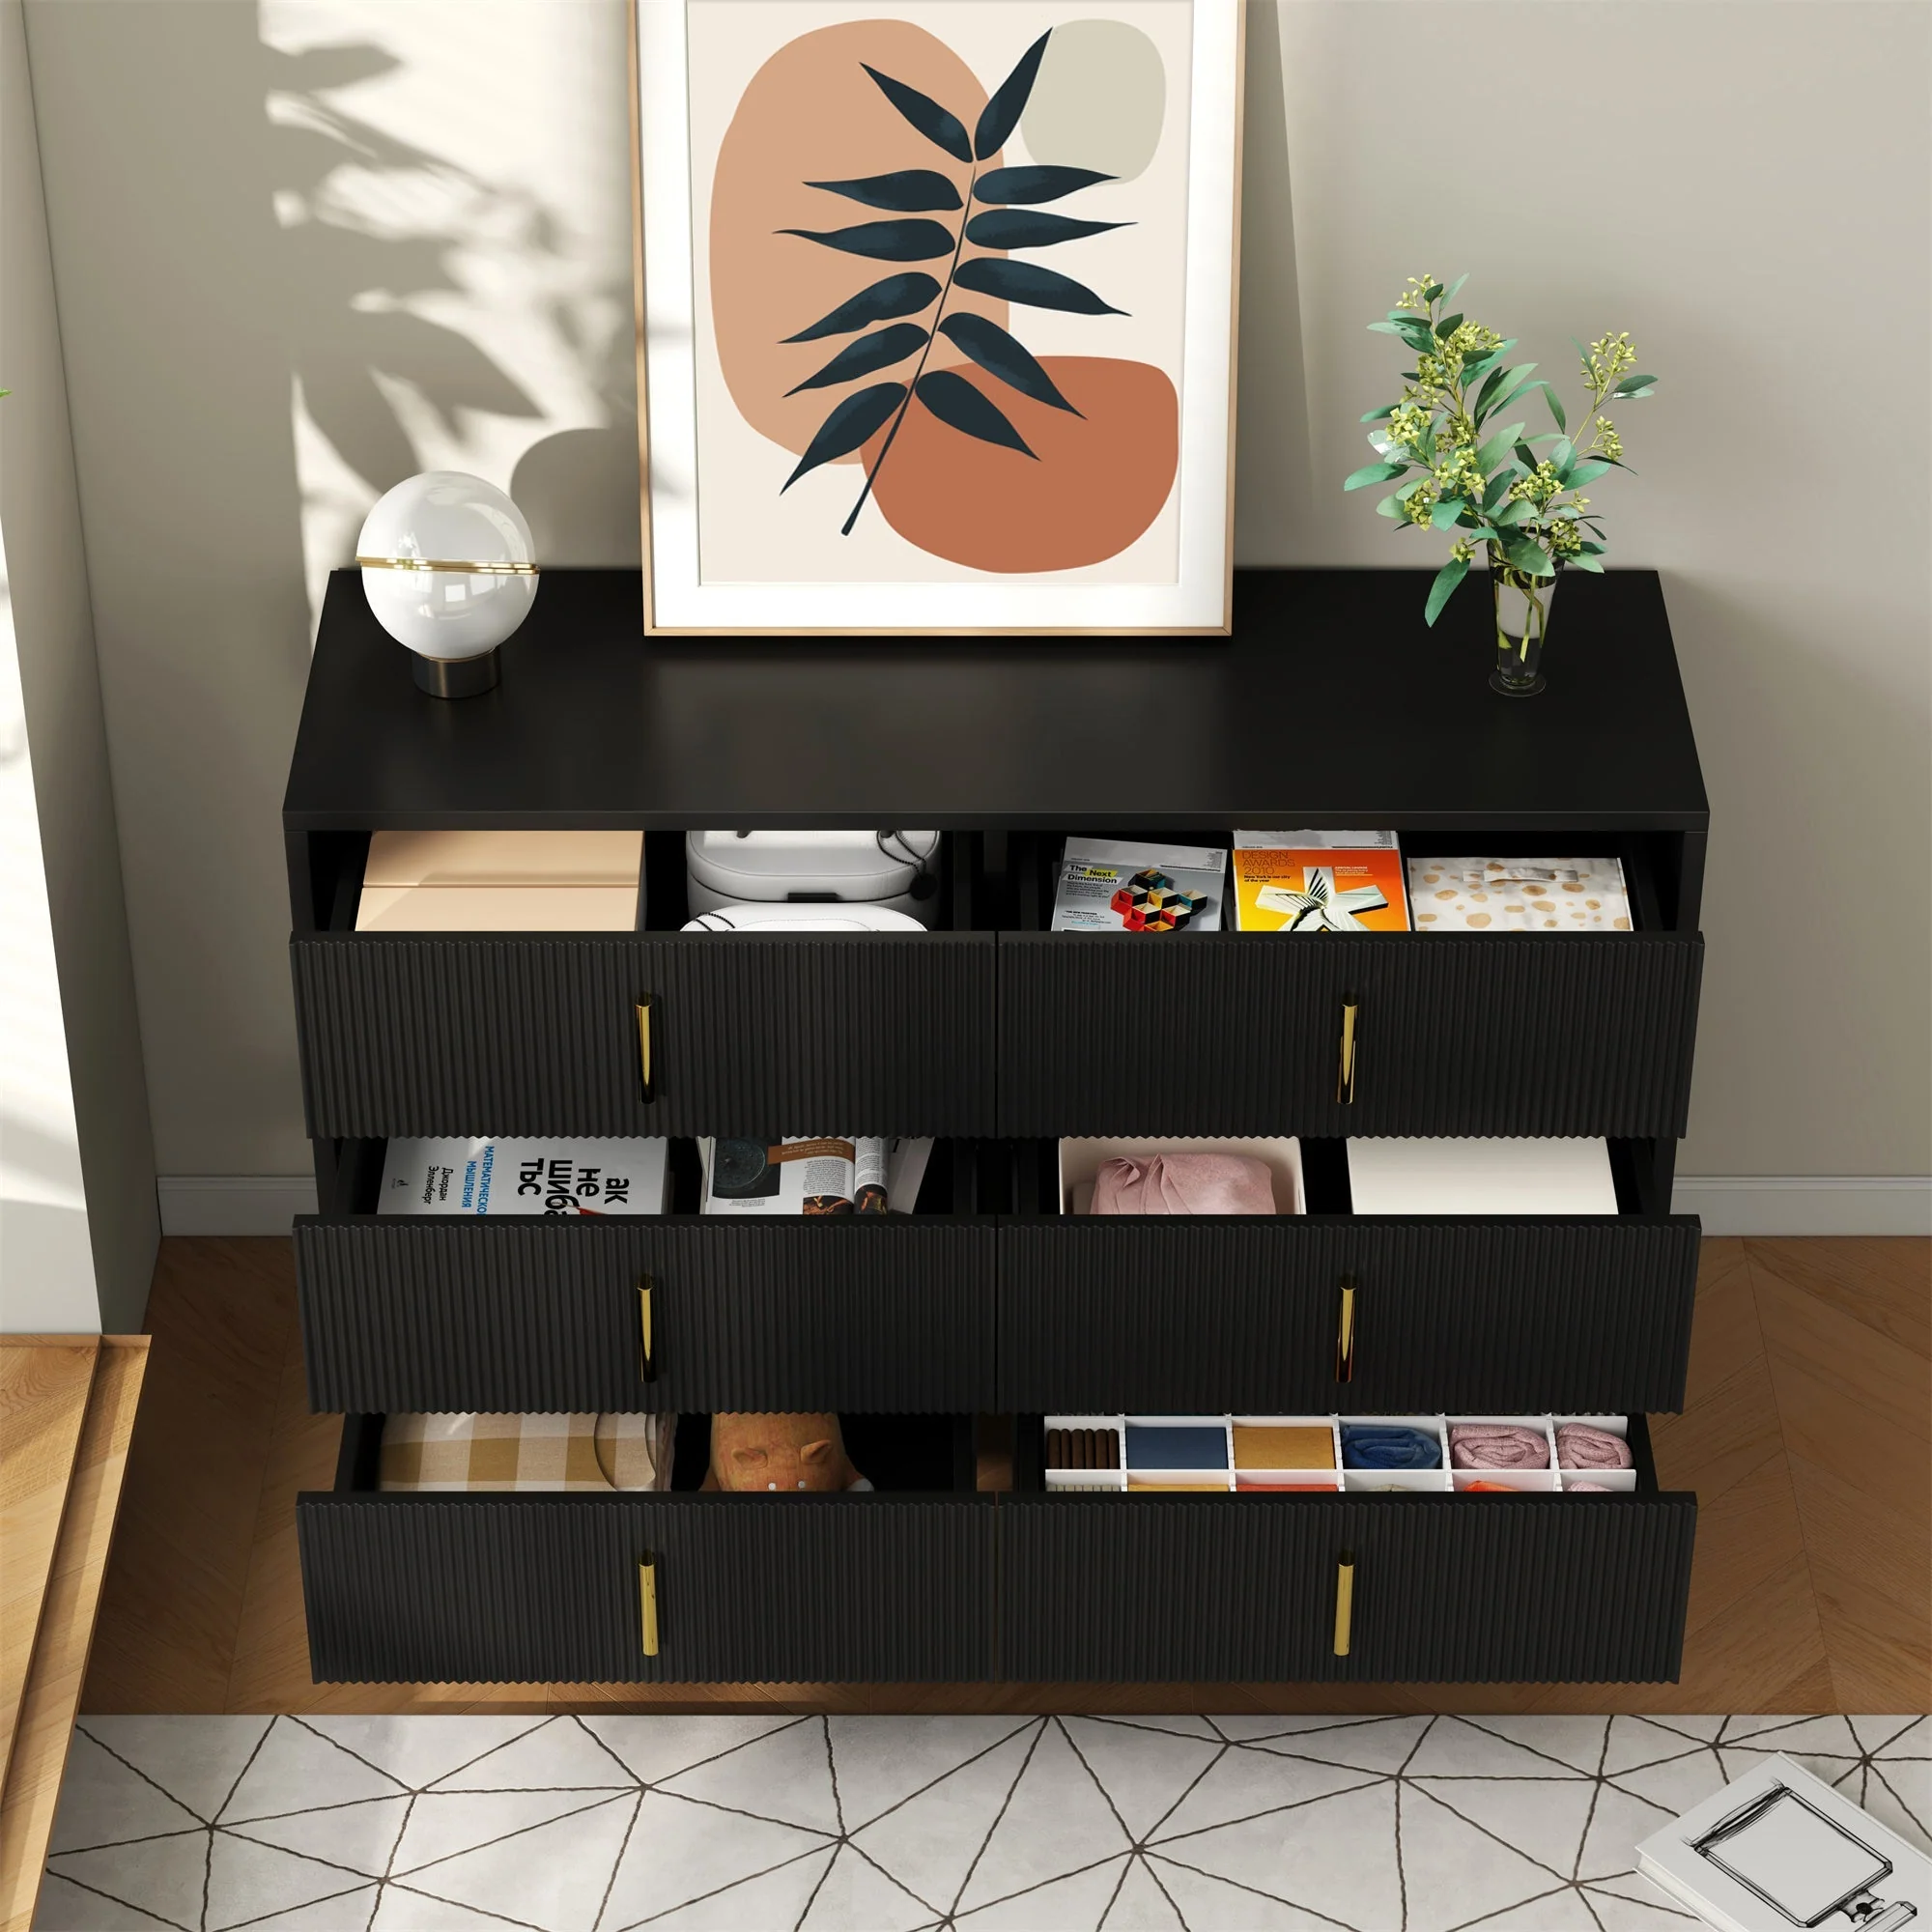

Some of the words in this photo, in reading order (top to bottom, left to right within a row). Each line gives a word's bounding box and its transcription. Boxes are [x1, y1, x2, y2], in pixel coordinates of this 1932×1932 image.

[1242, 850, 1289, 859] DESIGN
[1067, 874, 1117, 884] Dimension
[421, 1165, 440, 1205] Элленберг
[439, 1167, 454, 1201] Джордан
[461, 1160, 477, 1208] МЫШЛЕНИЯ
[517, 1157, 545, 1197] тьс
[576, 1168, 602, 1197] не
[604, 1178, 630, 1205] ак
